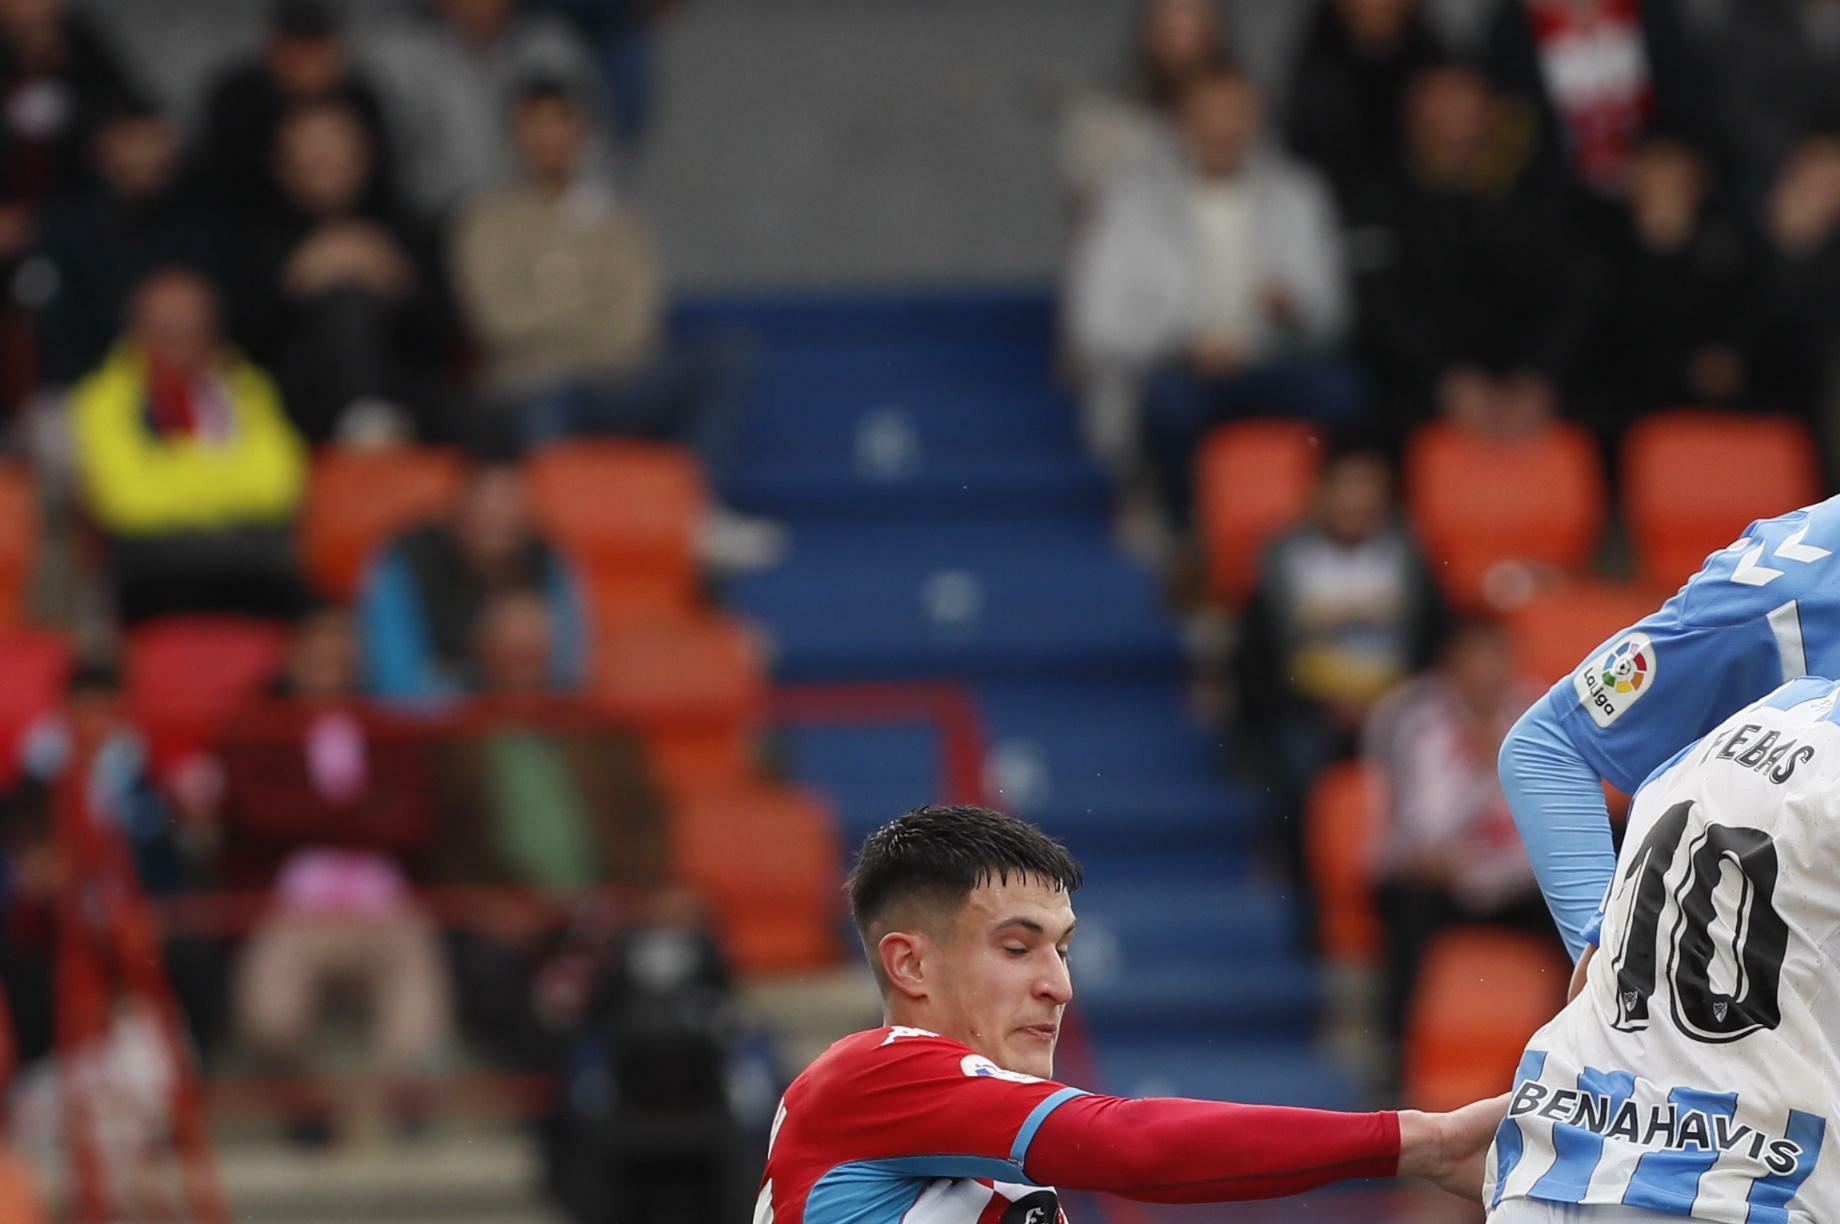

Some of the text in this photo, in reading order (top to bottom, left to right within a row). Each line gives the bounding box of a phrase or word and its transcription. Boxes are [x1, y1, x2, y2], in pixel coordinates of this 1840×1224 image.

[1584, 666, 1615, 716] LaLiga
[1699, 724, 1815, 785] FEBAS
[1609, 799, 1790, 1045] 10
[1509, 1081, 1801, 1175] BENAHAVIS
